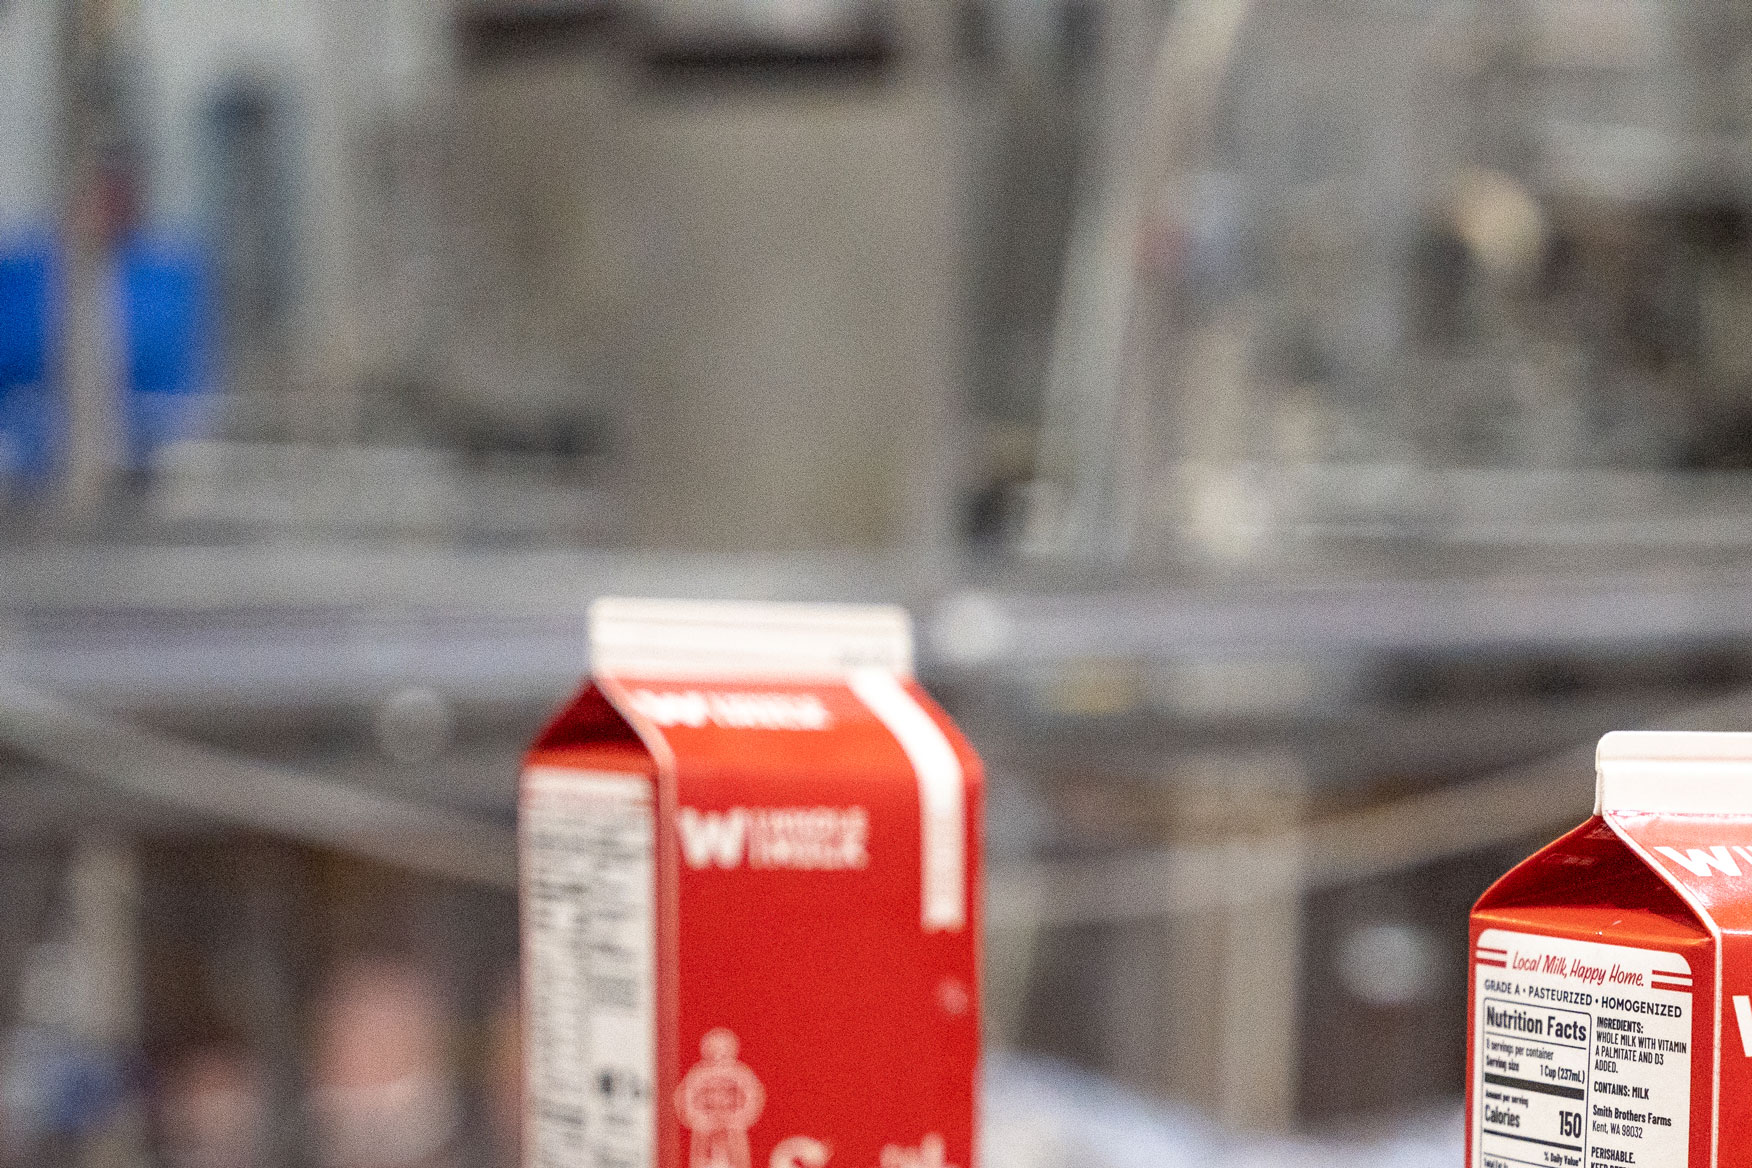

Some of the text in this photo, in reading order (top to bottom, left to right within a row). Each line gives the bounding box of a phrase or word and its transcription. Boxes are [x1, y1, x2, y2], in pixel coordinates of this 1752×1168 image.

[679, 808, 745, 868] W
[1654, 846, 1743, 877] W
[1512, 951, 1644, 987] Local Milk, Happy Home.
[1484, 979, 1682, 1018] GRADE A PASTEURIZED HOMOGENIZED
[1486, 1005, 1587, 1041] Nutrition Facts
[1597, 1016, 1644, 1034] INGREDIENTS:
[1491, 1040, 1514, 1056] servings
[1515, 1046, 1524, 1057] per
[1525, 1047, 1554, 1061] container
[1596, 1030, 1687, 1054] WHOLE MILK WITH VITAMIN
[1594, 1059, 1618, 1073] ADDED.
[1595, 1045, 1664, 1066] A PALMITATE AND D3
[1540, 1064, 1586, 1084] 1 Cup (237mL)
[1594, 1080, 1650, 1100] CONTAINS: MILK
[1485, 1104, 1520, 1128] Calories
[1559, 1110, 1582, 1139] 150
[1593, 1104, 1672, 1127] Smith Brothers Farms
[1592, 1120, 1643, 1139] Kent, WA 98032
[1550, 1153, 1563, 1166] Daily
[1591, 1146, 1636, 1164] PERISHABLE.
